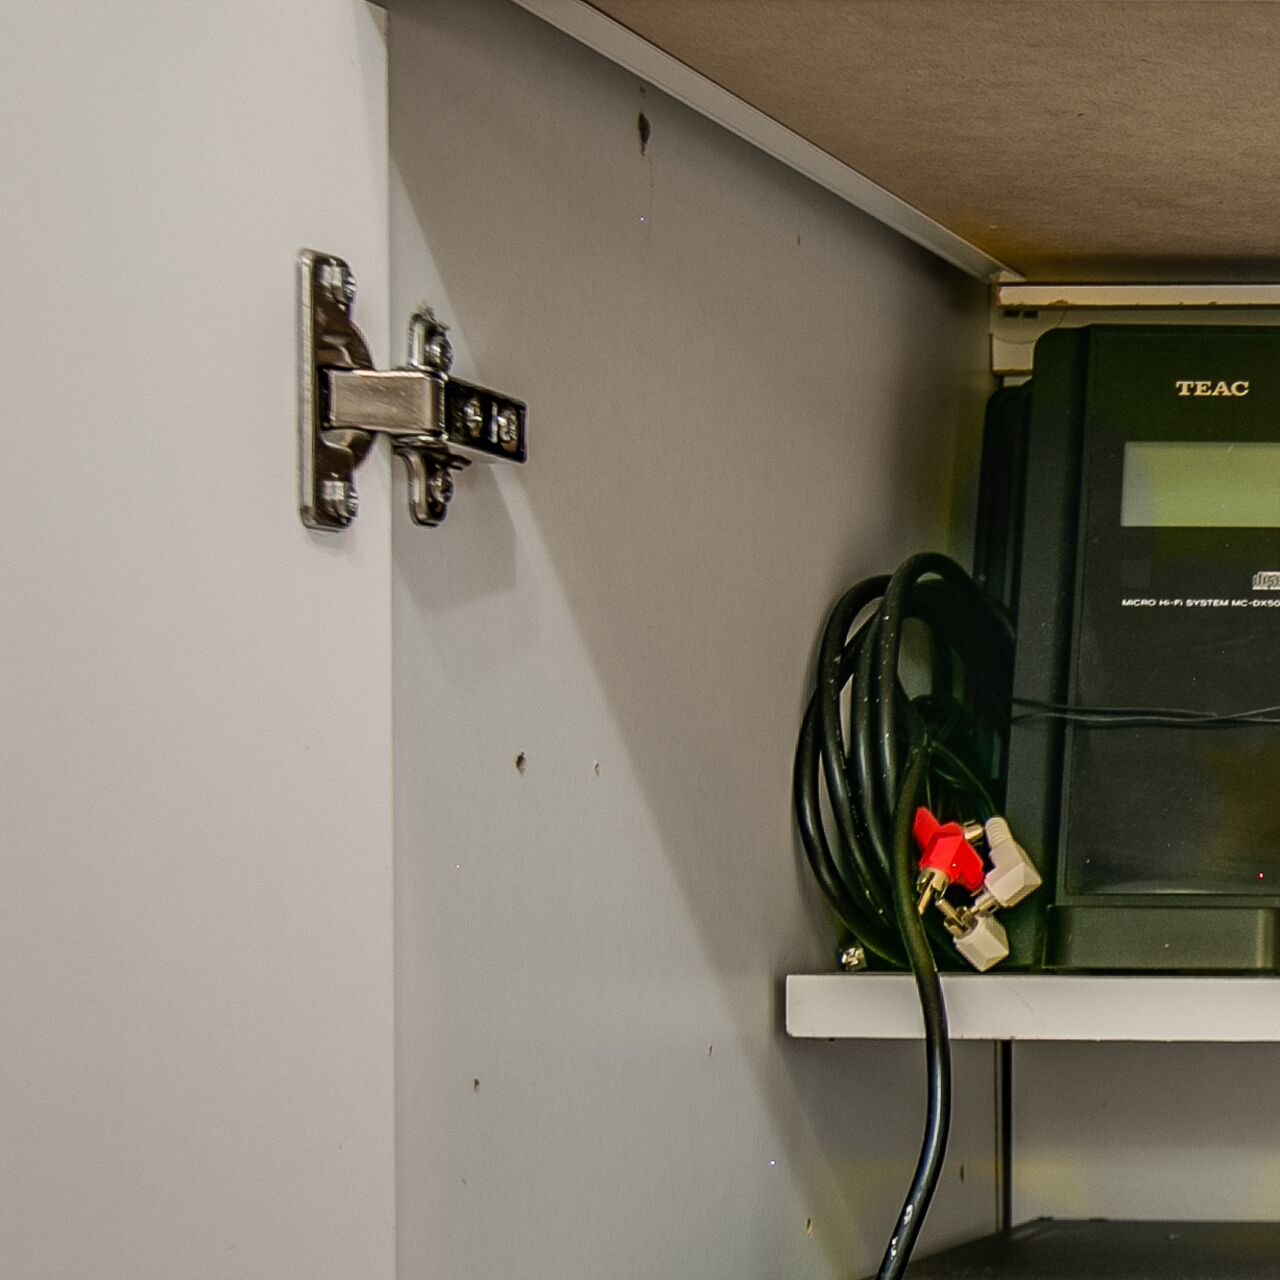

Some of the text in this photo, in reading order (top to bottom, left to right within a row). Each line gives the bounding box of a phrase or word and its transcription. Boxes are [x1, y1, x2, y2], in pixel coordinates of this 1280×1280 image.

[1175, 380, 1250, 397] TEAC
[1122, 598, 1157, 607] MICRO
[1159, 598, 1184, 607] Hi-Fi
[1185, 598, 1229, 607] SYSTEM
